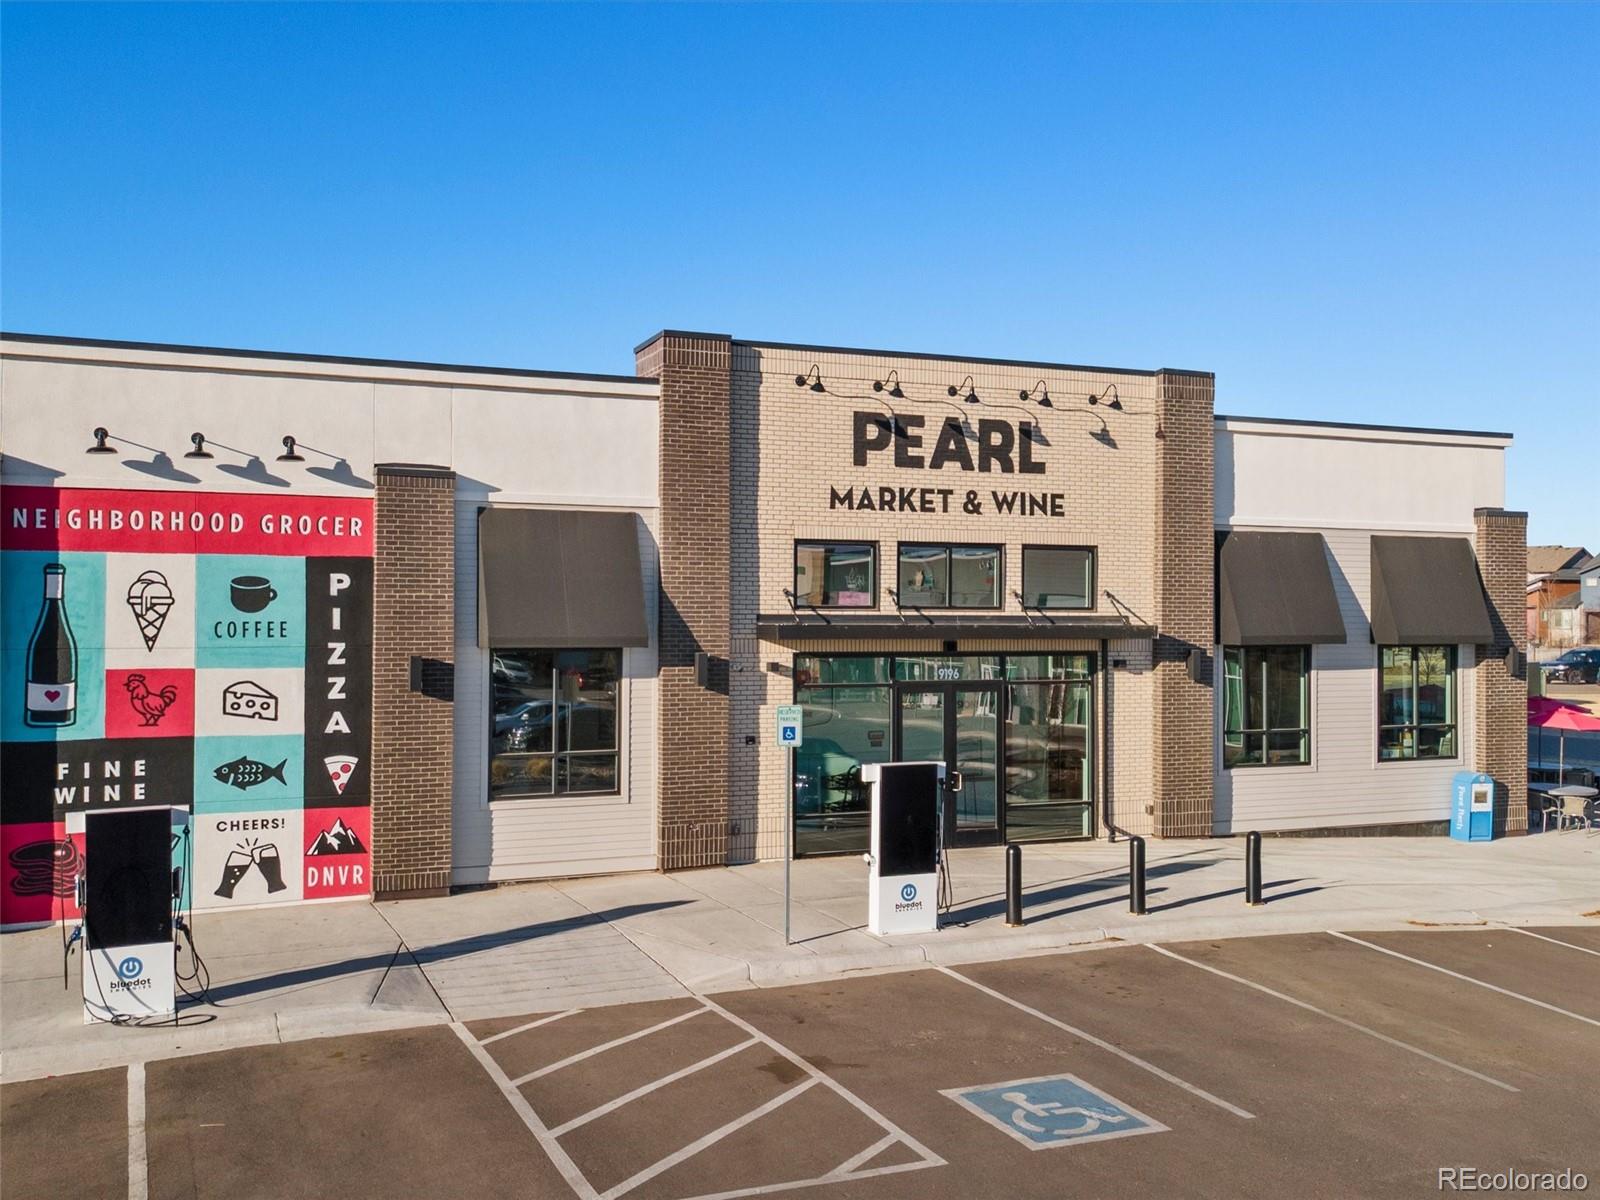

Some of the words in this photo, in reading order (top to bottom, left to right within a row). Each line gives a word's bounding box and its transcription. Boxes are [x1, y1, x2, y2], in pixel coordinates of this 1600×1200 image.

[853, 411, 1046, 474] PEARL
[829, 485, 954, 513] MARKET
[963, 490, 983, 515] &
[991, 490, 1065, 517] WINE
[12, 508, 245, 533] NEIGHBORHOOD
[260, 514, 364, 537] GROCER
[214, 621, 288, 639] COFFEE
[324, 572, 351, 734] PIZZA
[938, 668, 960, 680] 9196
[57, 760, 147, 780] FINE
[54, 783, 147, 804] WINE
[216, 818, 286, 832] CHEERS!
[307, 865, 365, 887] DNVR
[110, 978, 152, 989] bluedot
